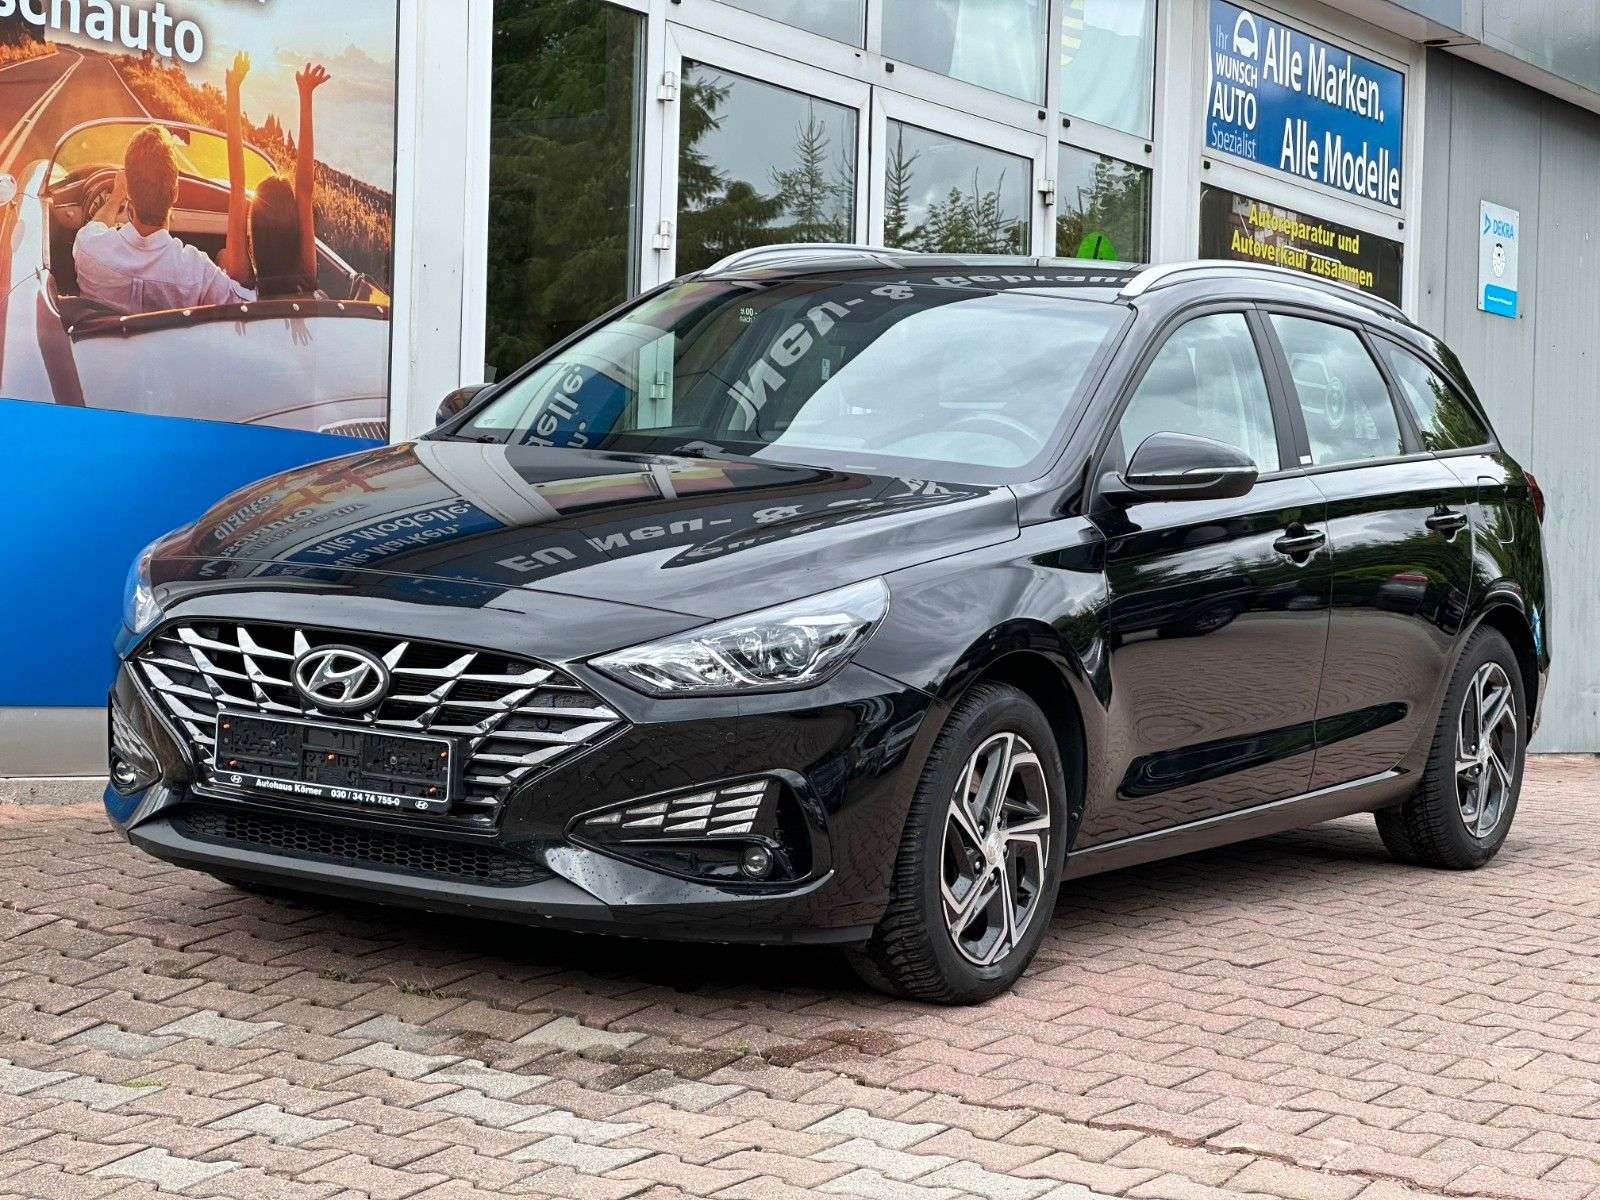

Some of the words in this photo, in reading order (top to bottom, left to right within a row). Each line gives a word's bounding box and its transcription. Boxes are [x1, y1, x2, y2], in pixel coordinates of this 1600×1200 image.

[1215, 23, 1230, 50] Ihr
[1215, 51, 1258, 89] WUNSCH
[1263, 27, 1303, 92] Alle
[1308, 43, 1385, 123] Marken.
[1212, 81, 1257, 131] AUTO
[1211, 121, 1256, 161] Spezialist
[1280, 117, 1319, 180] Alle
[1323, 131, 1399, 206] Modelle
[1248, 204, 1336, 247] Autoreparatur
[1338, 233, 1361, 255] und
[1493, 219, 1515, 239] DEKRA
[1231, 229, 1309, 270] Autoverkauf
[1311, 255, 1374, 288] zusammen
[255, 778, 293, 792] Autohaus
[294, 783, 323, 796] Körner
[330, 789, 347, 799] 030
[352, 792, 363, 802] 34
[364, 794, 376, 804] 74
